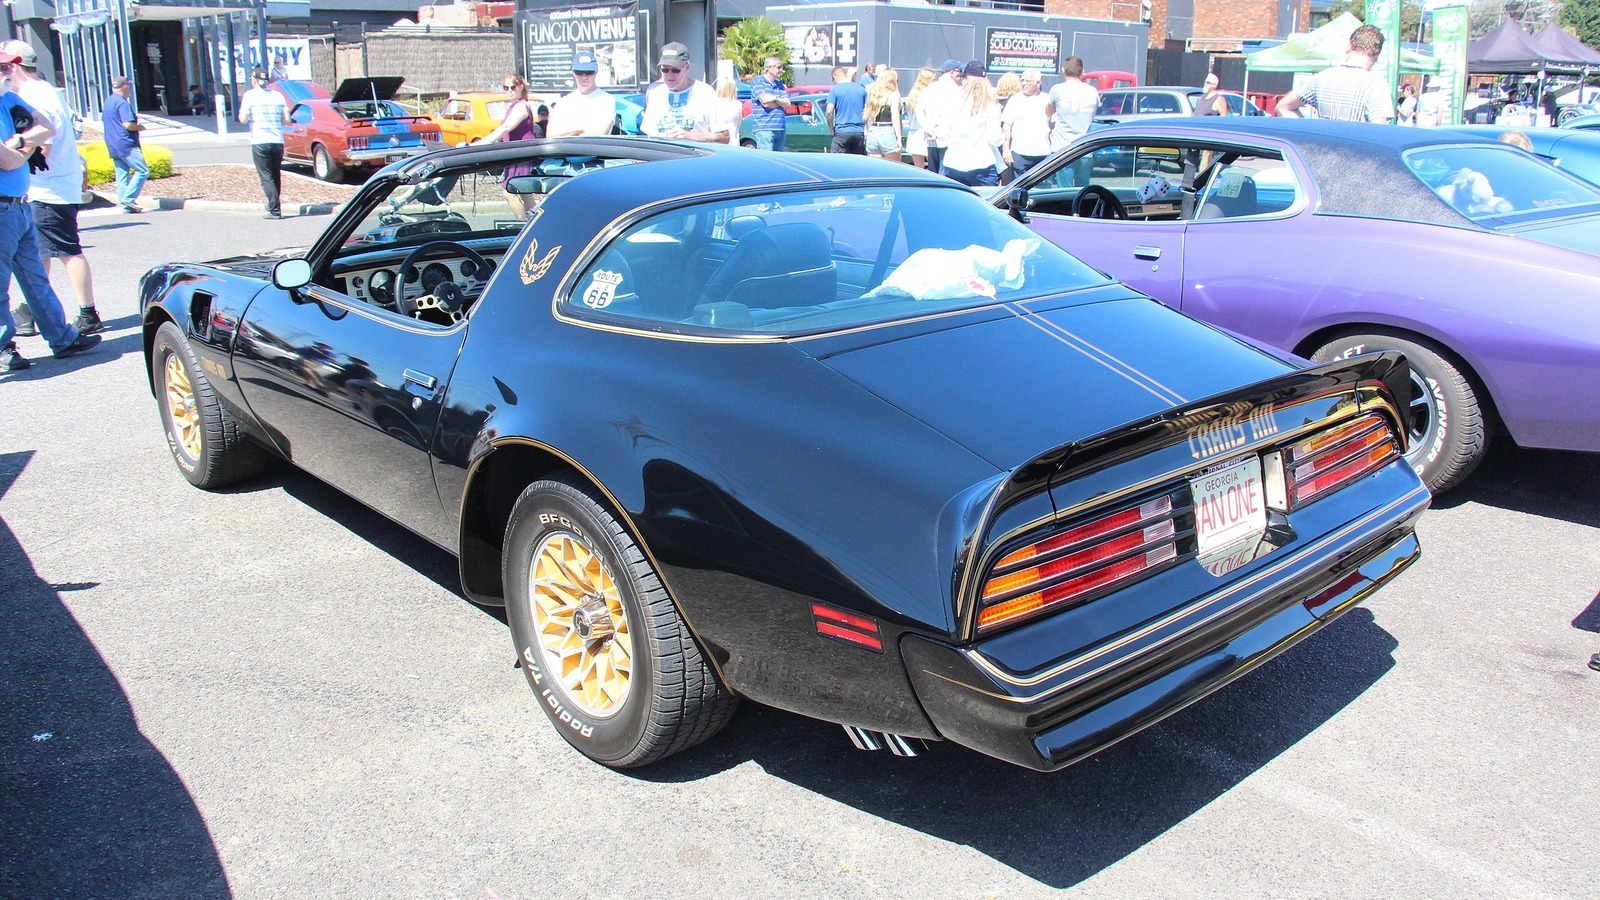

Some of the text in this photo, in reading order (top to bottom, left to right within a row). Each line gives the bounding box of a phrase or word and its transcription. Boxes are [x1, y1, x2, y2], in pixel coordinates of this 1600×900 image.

[990, 37, 1012, 50] SOLID
[1012, 39, 1034, 51] GOLD
[597, 272, 619, 282] ROUTE
[587, 289, 609, 306] 66
[1426, 377, 1448, 463] AVENGER
[1205, 471, 1239, 492] GEORGIA
[1226, 477, 1258, 523] ONE
[523, 645, 594, 738] Radial T/A
